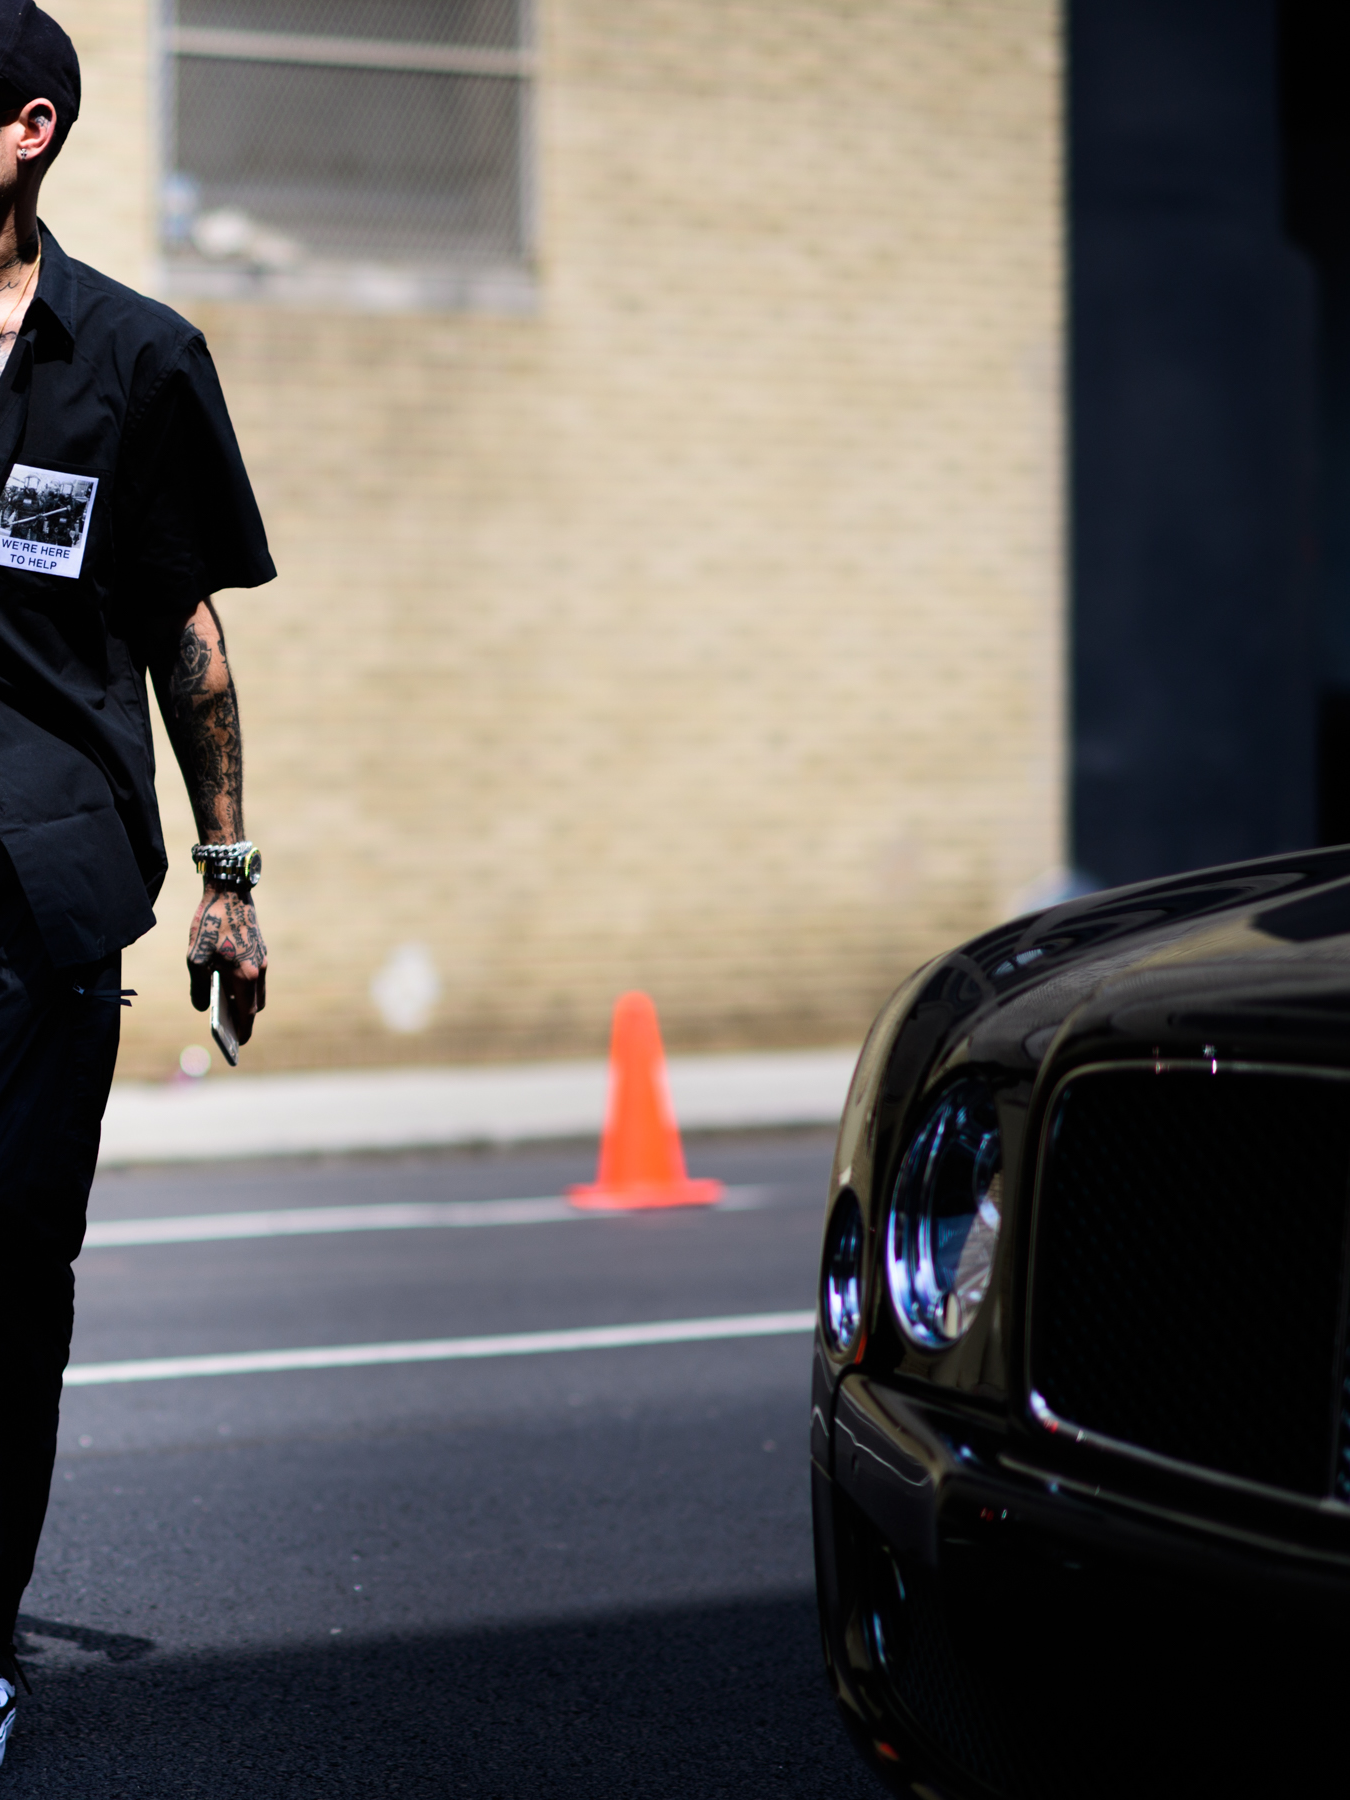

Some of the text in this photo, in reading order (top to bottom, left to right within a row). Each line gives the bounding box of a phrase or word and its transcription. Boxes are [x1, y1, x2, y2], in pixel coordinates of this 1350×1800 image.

[1, 538, 71, 559] WE'RE HERE
[10, 553, 57, 570] TO HELP
